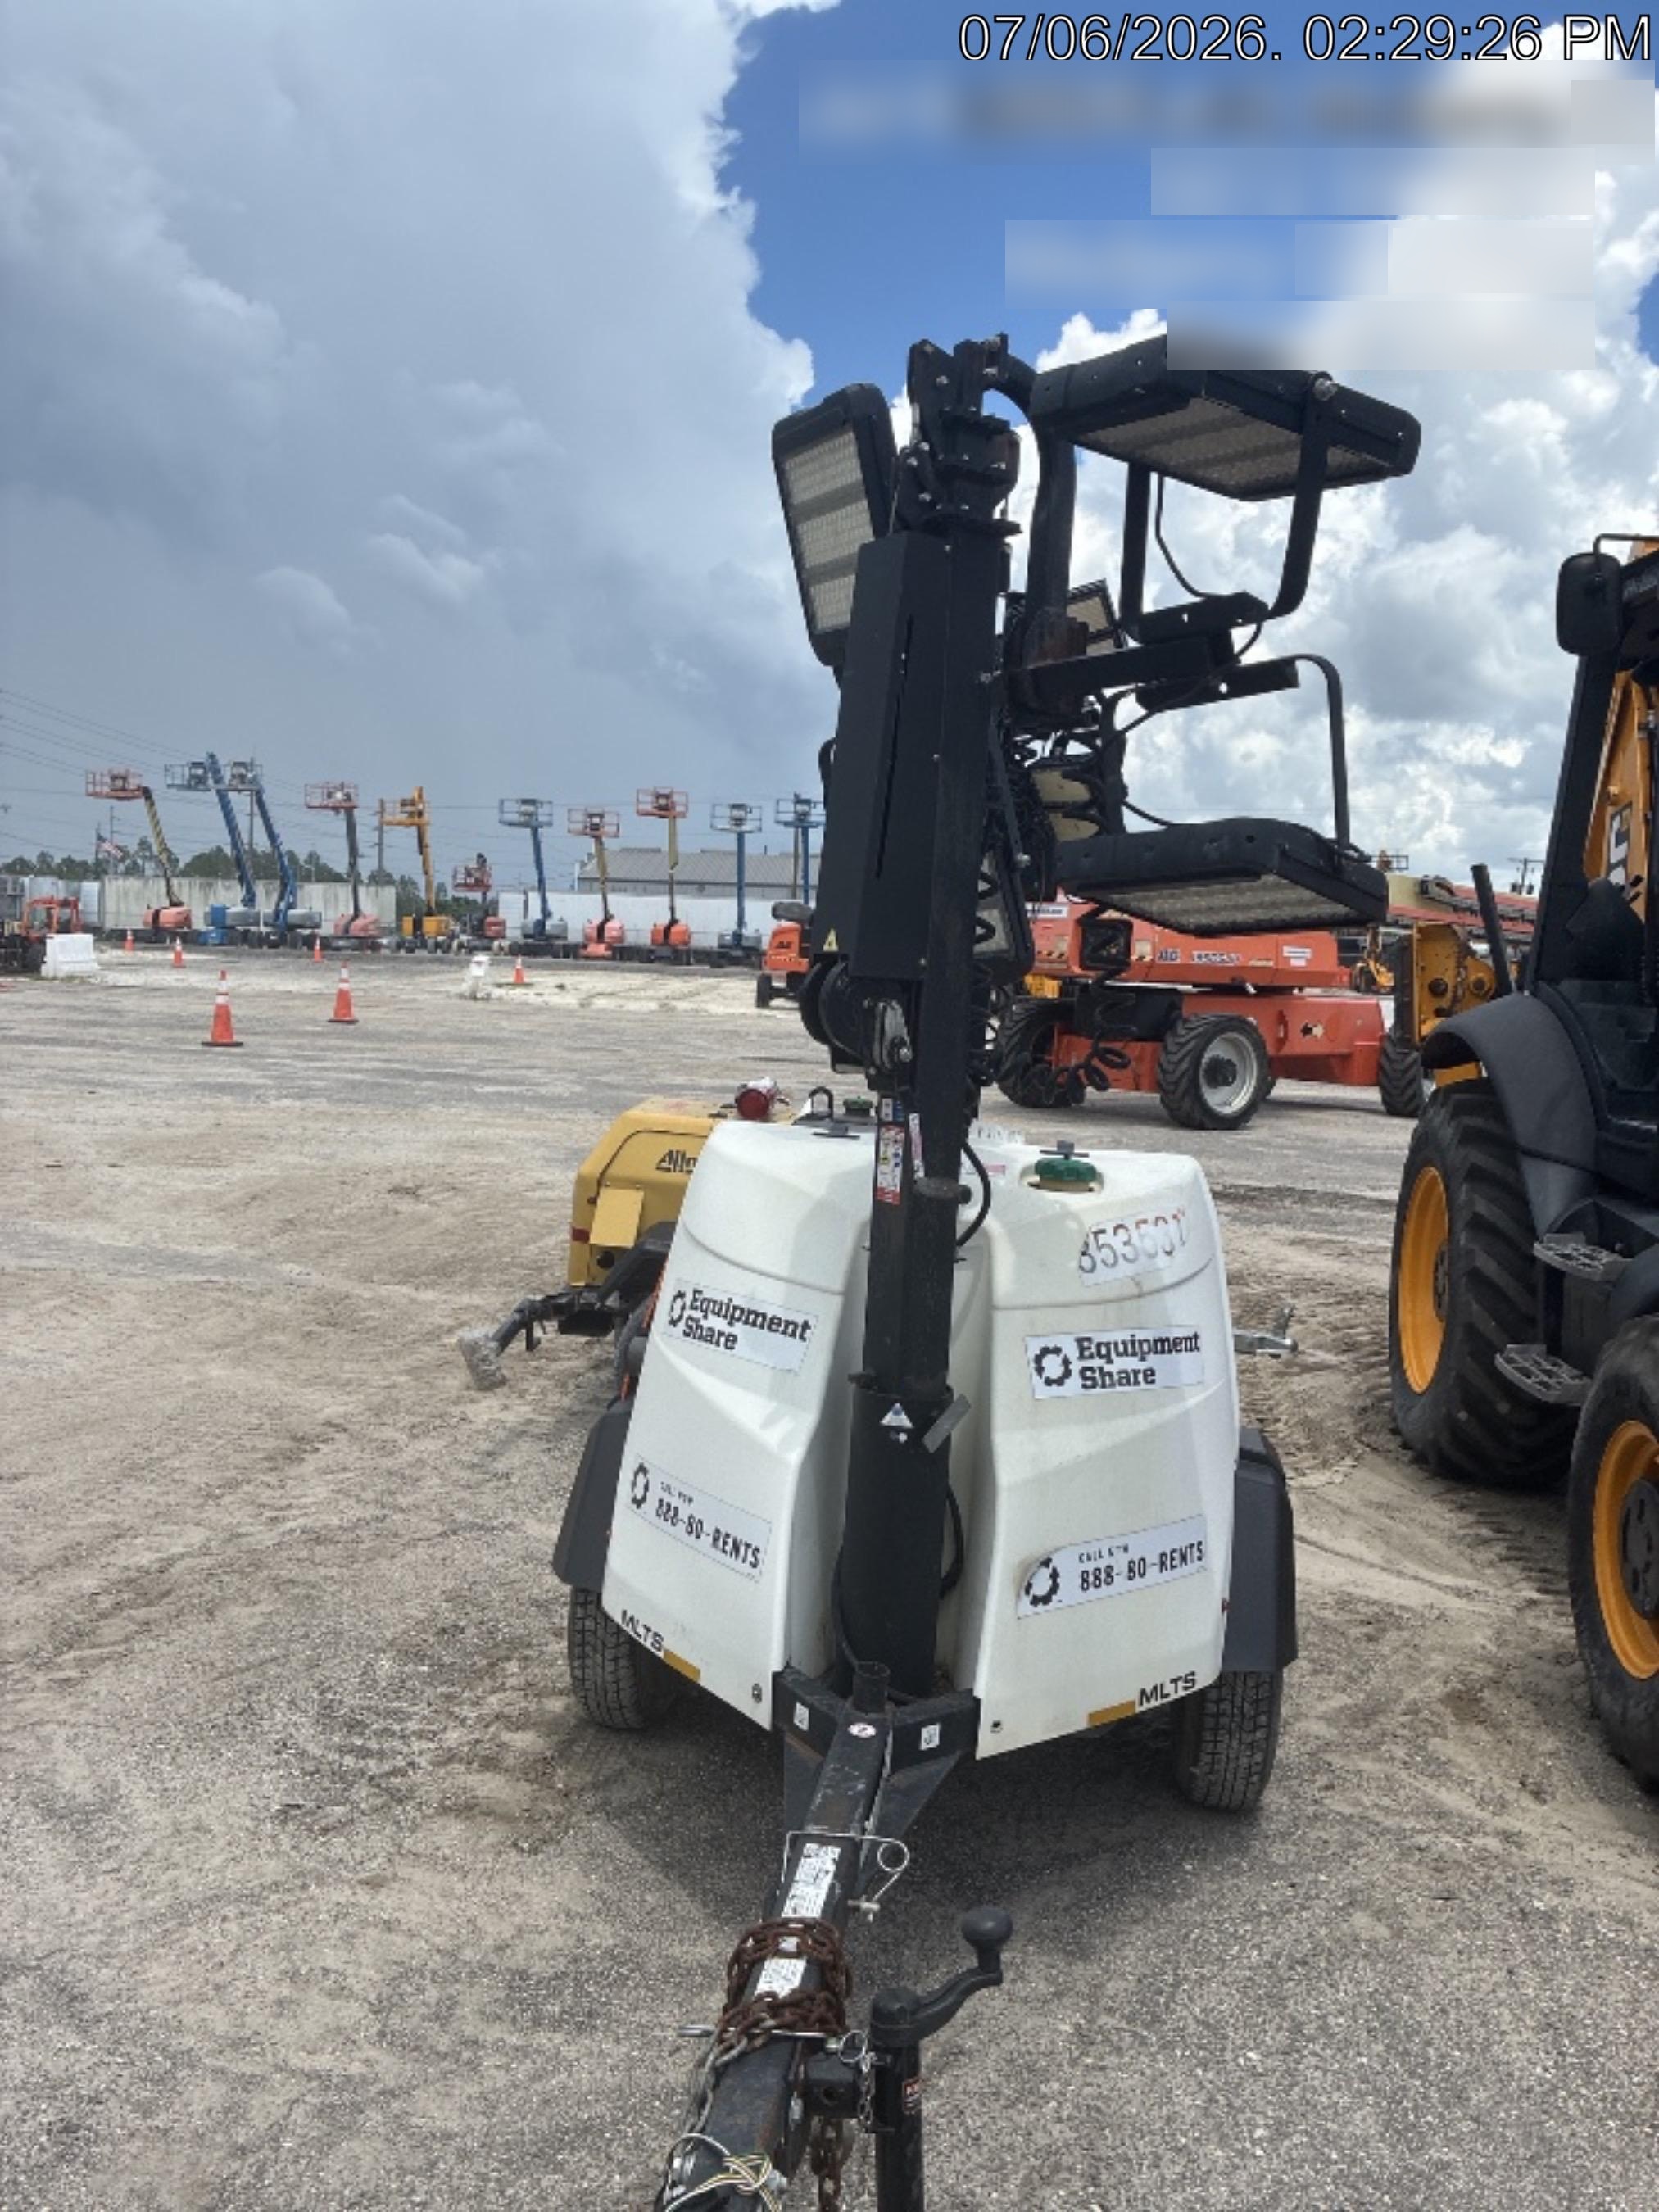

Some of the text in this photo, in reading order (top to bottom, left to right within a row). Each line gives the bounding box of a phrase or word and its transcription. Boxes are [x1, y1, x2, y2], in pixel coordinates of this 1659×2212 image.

[682, 1314, 738, 1350] Share
[688, 1287, 812, 1342] Equipment
[1075, 1330, 1200, 1364] Equipment
[1079, 1366, 1156, 1389] Share
[621, 1609, 664, 1652] MLTS
[1140, 1670, 1196, 1707] MLTS
